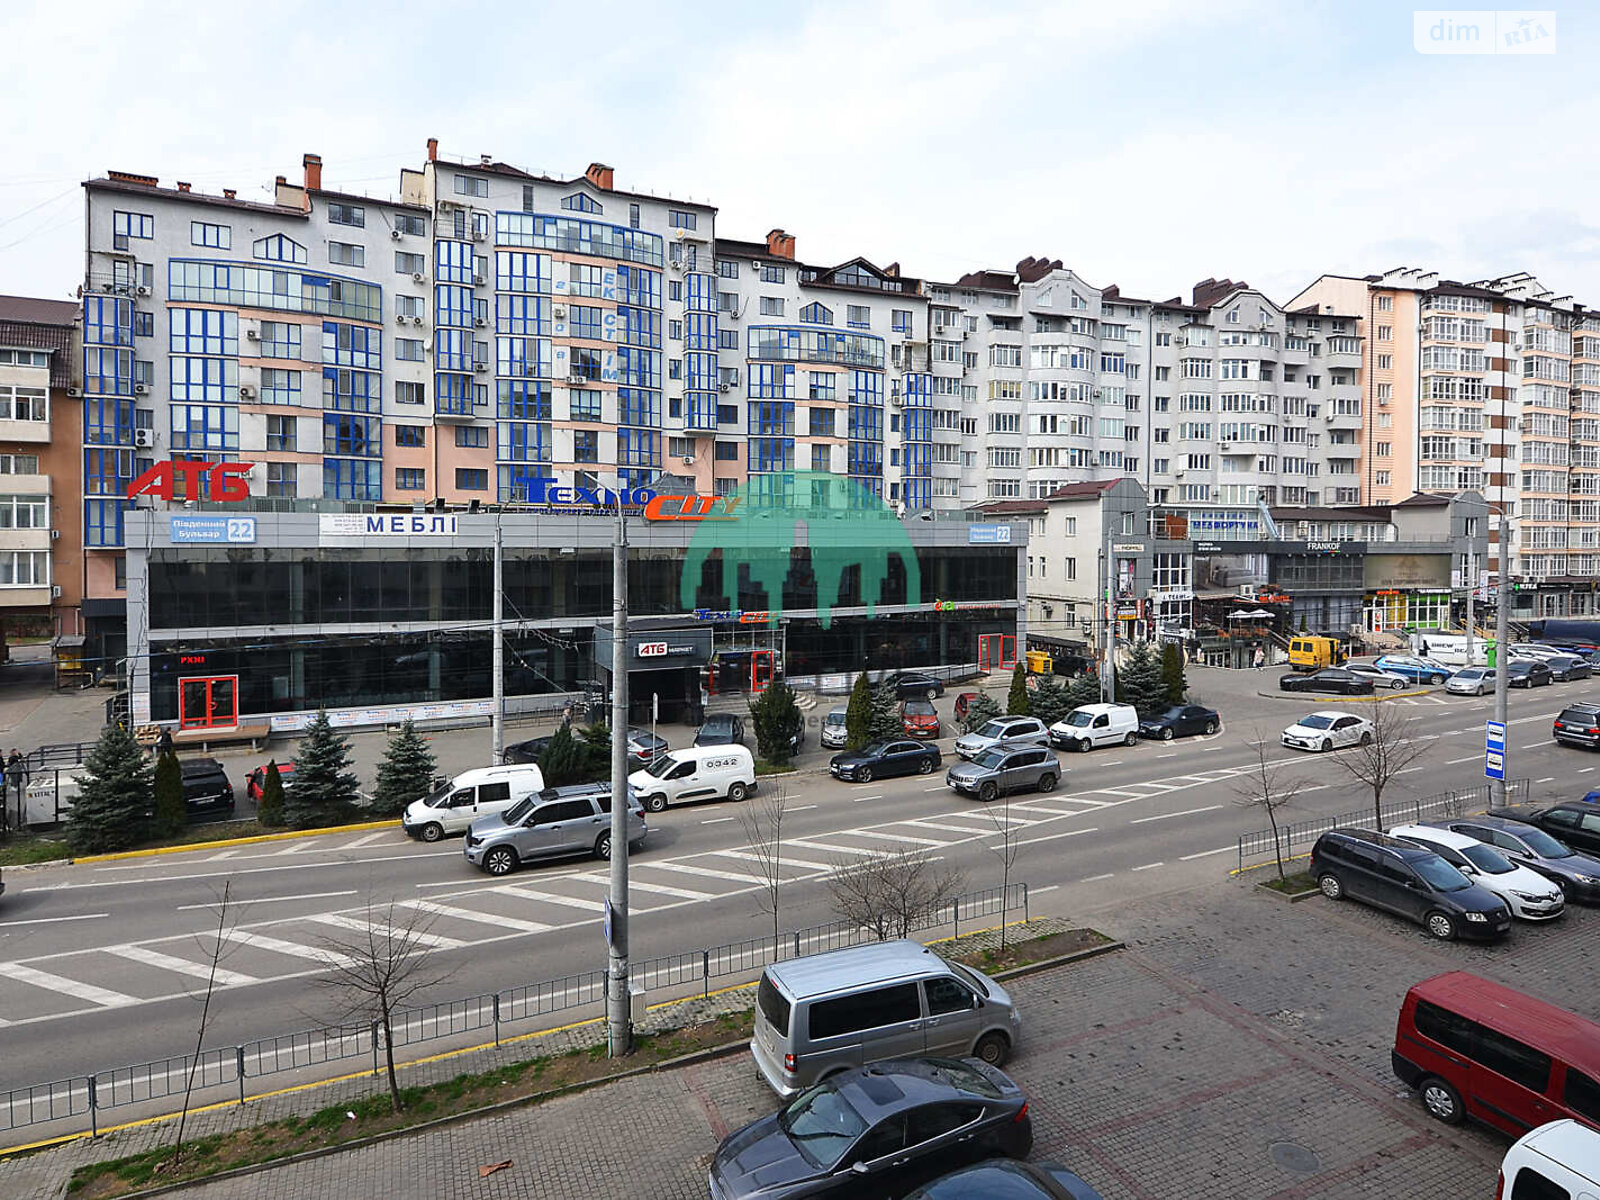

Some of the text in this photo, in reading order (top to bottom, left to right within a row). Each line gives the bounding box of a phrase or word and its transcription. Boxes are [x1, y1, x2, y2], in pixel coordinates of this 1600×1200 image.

[126, 460, 254, 502] АТБ
[230, 522, 252, 538] 22
[366, 516, 457, 533] МЕБЛІ
[1307, 542, 1341, 550] FRANKOF
